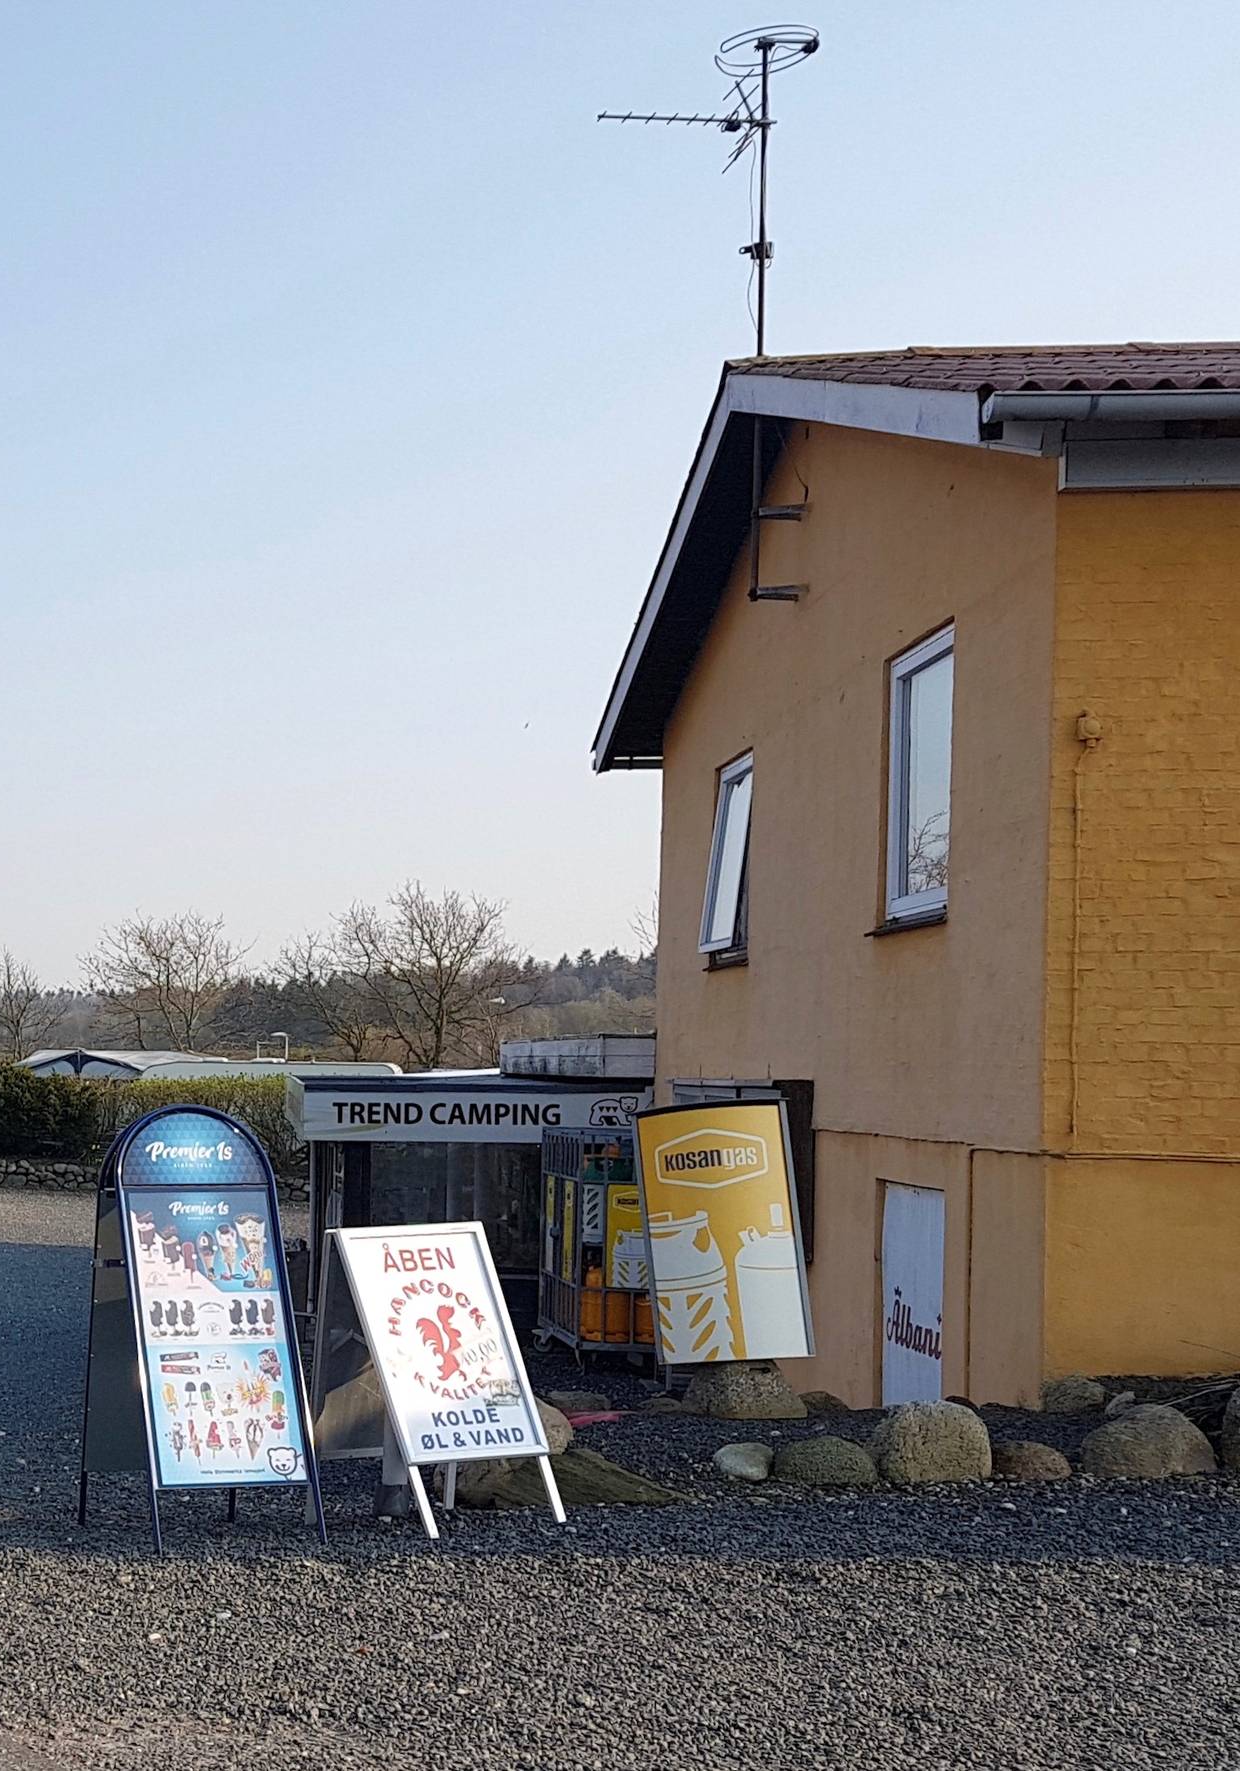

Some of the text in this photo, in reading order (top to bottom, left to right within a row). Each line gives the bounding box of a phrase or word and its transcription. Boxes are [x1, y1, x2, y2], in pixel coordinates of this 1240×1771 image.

[332, 1101, 562, 1126] TREND CAMPING
[145, 1140, 215, 1162] Premier
[168, 1200, 217, 1216] Premier
[382, 1242, 456, 1274] ÅBEN
[388, 1278, 487, 1337] HANCOCK
[886, 1297, 943, 1360] Albani
[413, 1366, 493, 1402] KVALITET
[431, 1407, 501, 1428] KOLDE
